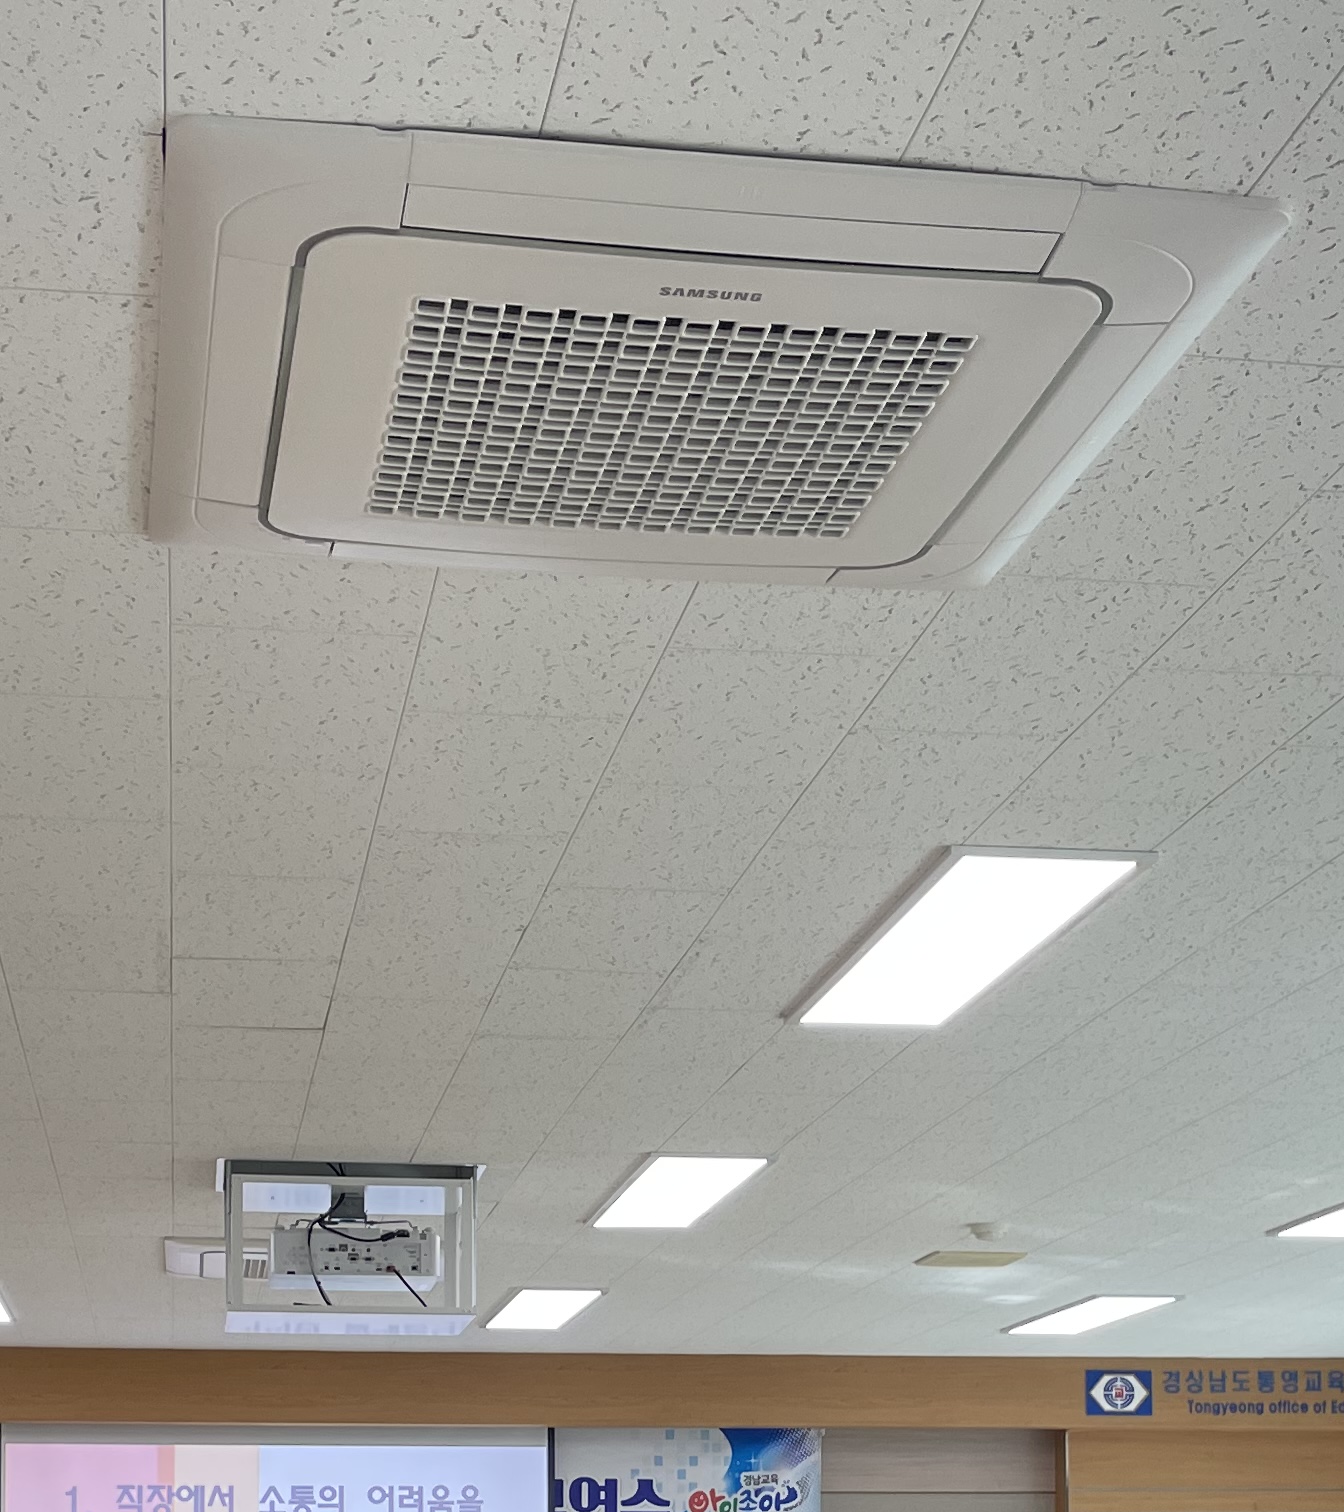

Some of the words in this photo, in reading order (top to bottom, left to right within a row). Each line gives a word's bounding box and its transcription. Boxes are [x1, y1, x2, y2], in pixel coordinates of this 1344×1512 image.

[659, 286, 763, 302] SAMSUNG
[1187, 1399, 1264, 1416] Tongyeong
[1268, 1399, 1309, 1415] office
[1313, 1399, 1327, 1415] of
[744, 1473, 779, 1486] 경남교육
